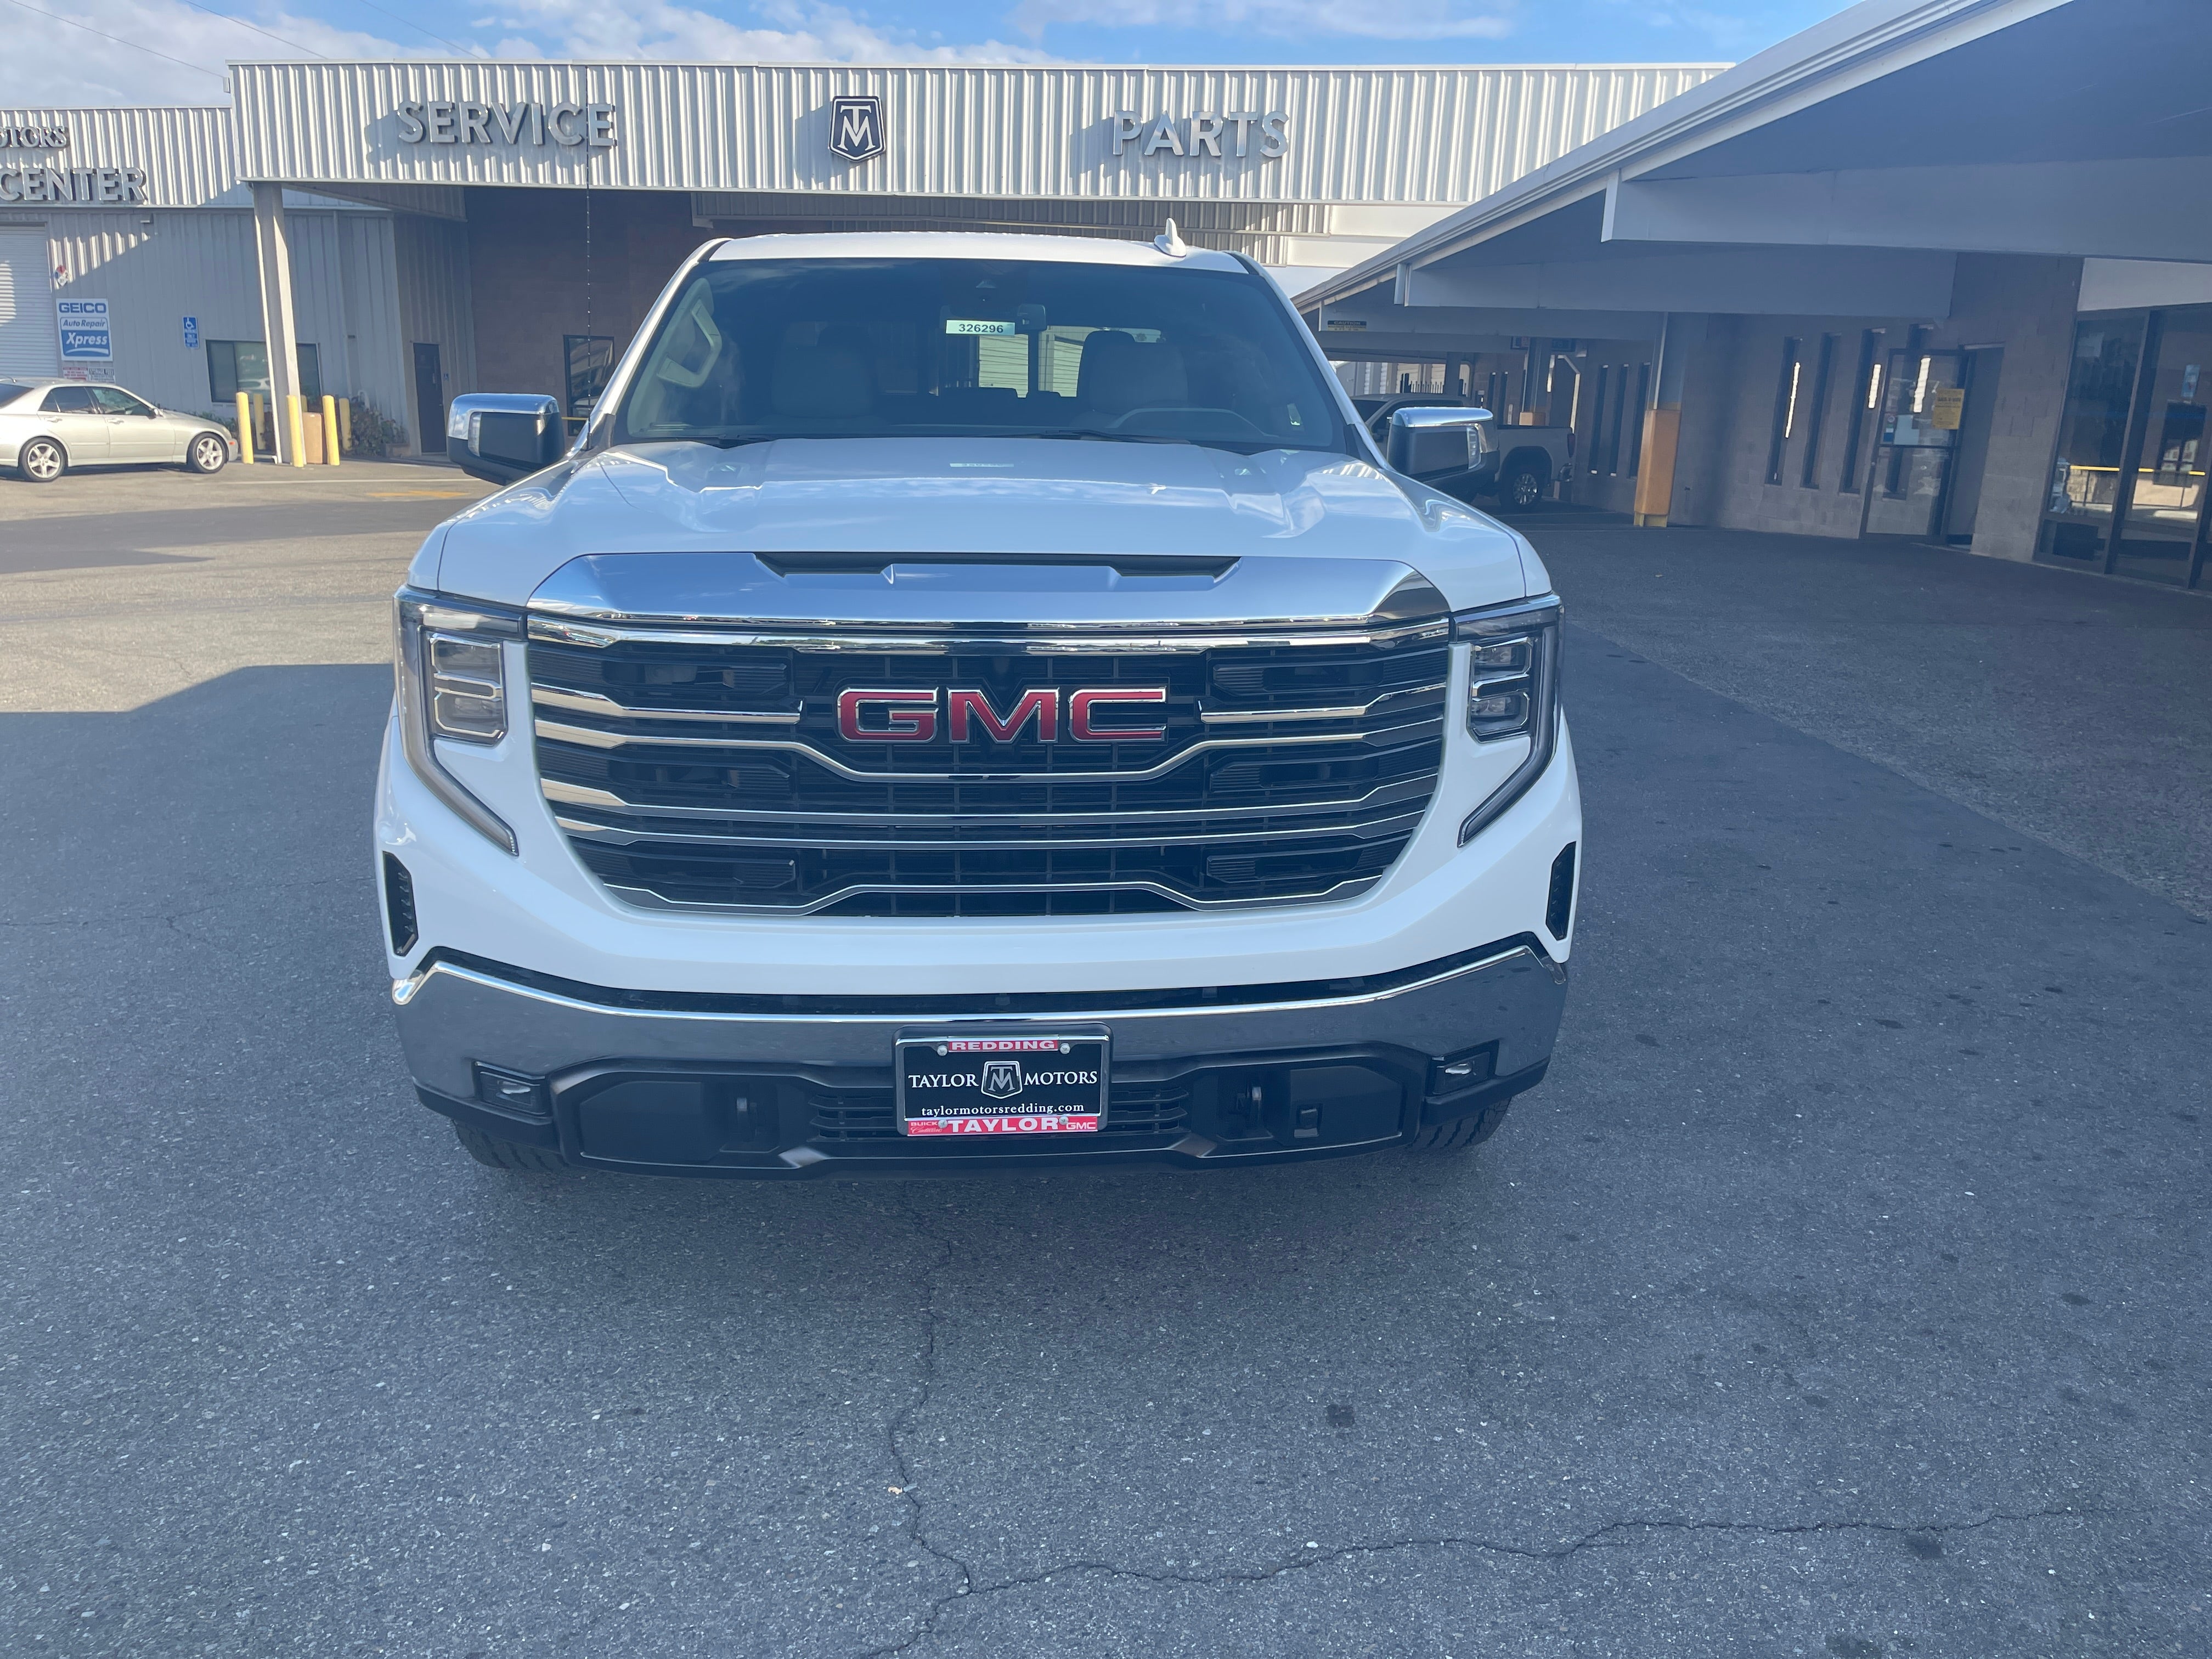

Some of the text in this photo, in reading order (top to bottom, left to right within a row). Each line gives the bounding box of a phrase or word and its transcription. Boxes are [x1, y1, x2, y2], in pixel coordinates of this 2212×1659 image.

[397, 100, 617, 146] SERVICE
[1112, 110, 1290, 157] PARTS
[0, 167, 147, 201] CENTER
[59, 302, 106, 313] GEICO
[63, 319, 106, 329] Auto Repair
[958, 324, 1003, 333] 326296
[66, 332, 108, 348] Xpress
[837, 687, 1167, 744] GMC
[951, 1040, 1055, 1050] REDDING
[909, 1074, 979, 1088] TAYLOR
[1024, 1071, 1097, 1086] MOTORS
[922, 1103, 1084, 1117] taylormotorsredding.com
[948, 1118, 1058, 1132] TAYLOR
[1066, 1122, 1097, 1130] GMC
